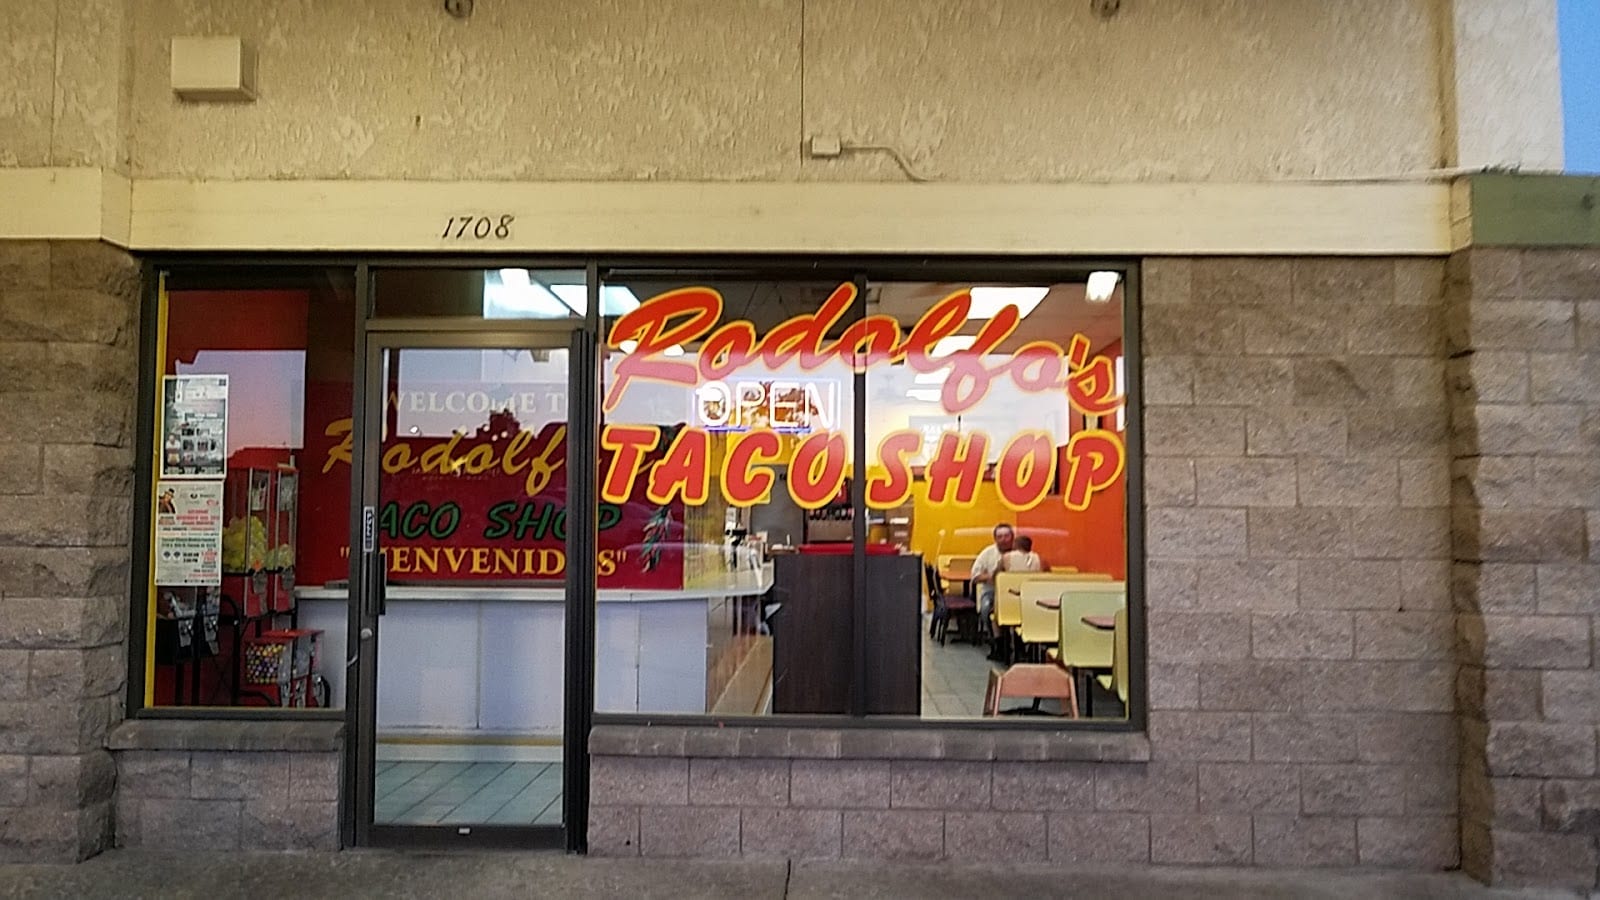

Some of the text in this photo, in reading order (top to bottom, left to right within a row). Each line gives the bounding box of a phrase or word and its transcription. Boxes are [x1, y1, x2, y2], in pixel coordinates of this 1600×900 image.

[442, 214, 515, 240] 1708
[602, 282, 1126, 414] Rodolfo's
[545, 391, 568, 413] T
[698, 381, 835, 428] OPEN
[599, 425, 1126, 512] TACO SHOP
[380, 502, 461, 541] ACO
